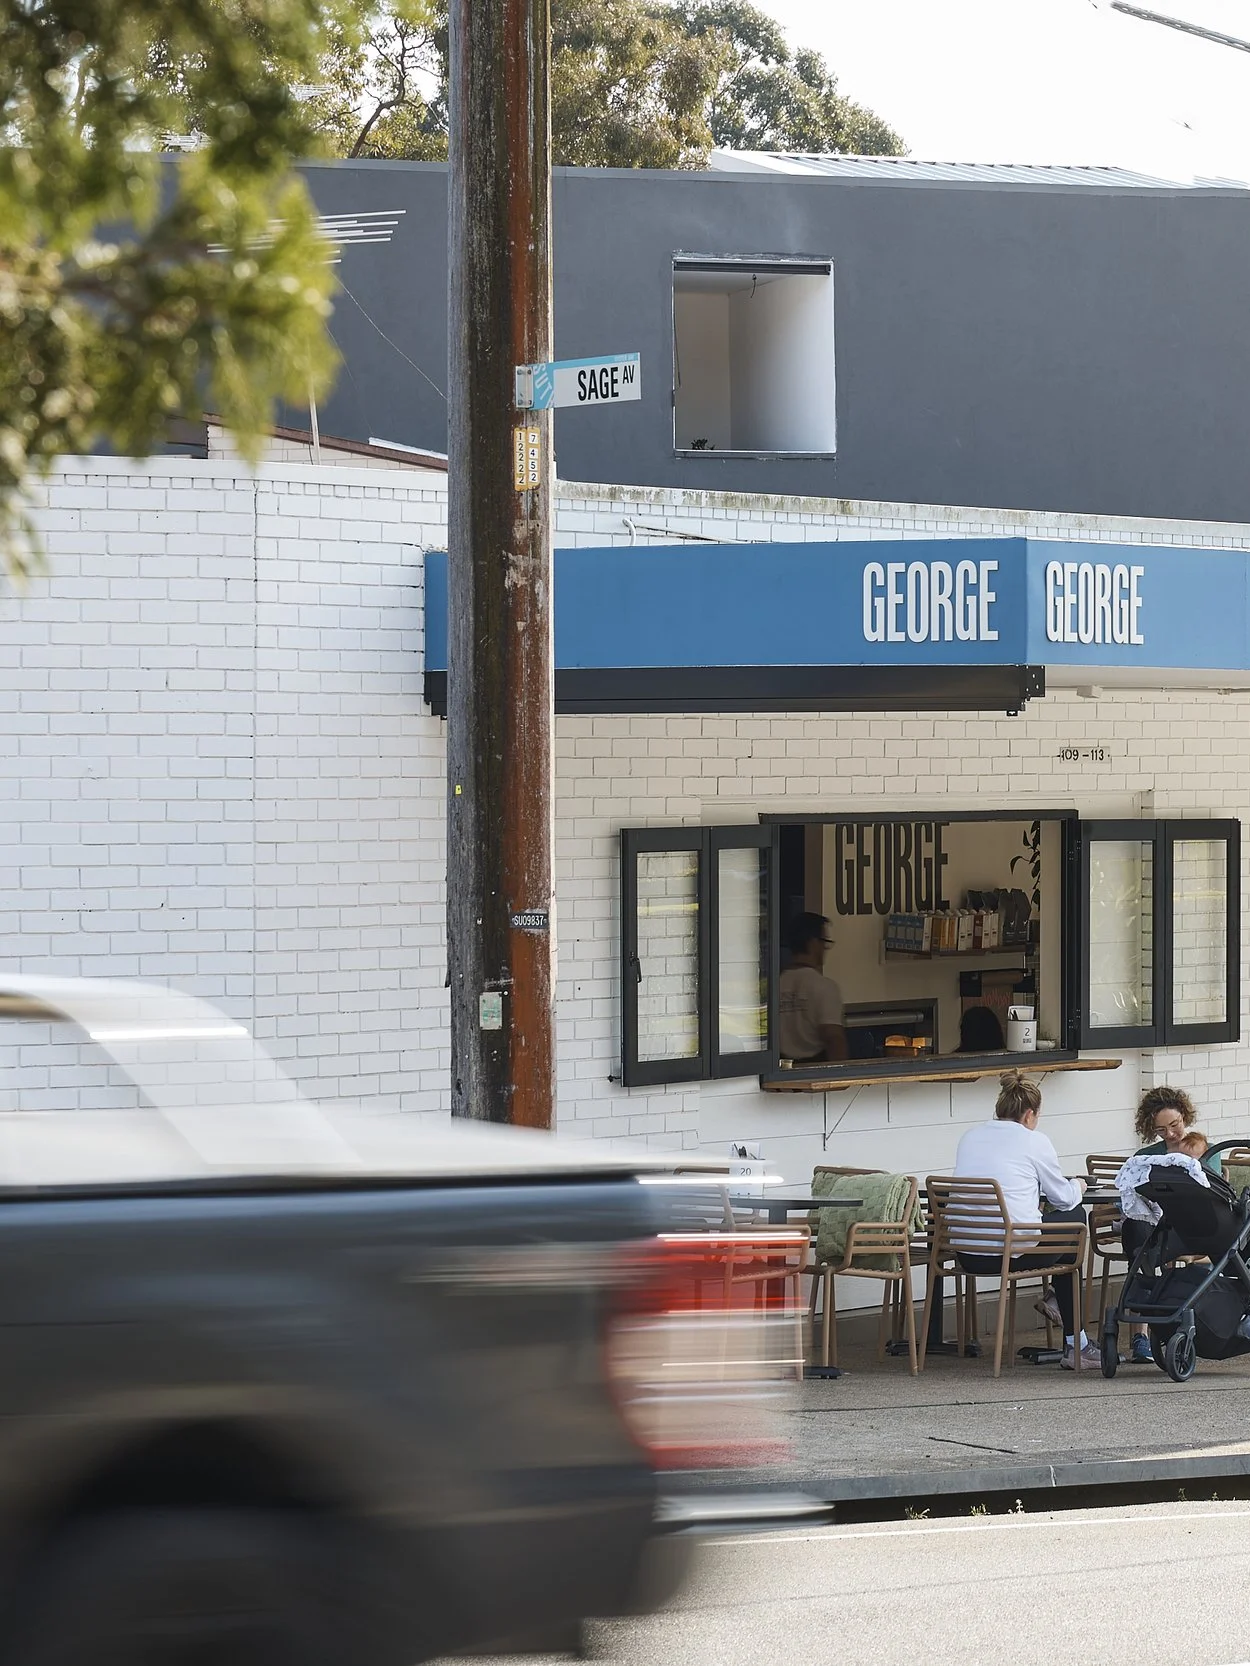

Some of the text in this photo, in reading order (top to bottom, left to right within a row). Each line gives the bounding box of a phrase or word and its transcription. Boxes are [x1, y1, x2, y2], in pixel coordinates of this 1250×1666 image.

[577, 364, 635, 401] SAGE AV
[862, 559, 999, 643] GEORGE
[1046, 560, 1144, 645] GEORGE
[835, 822, 950, 916] GEORGE
[1024, 1027, 1031, 1037] 2
[740, 1167, 752, 1176] 20
